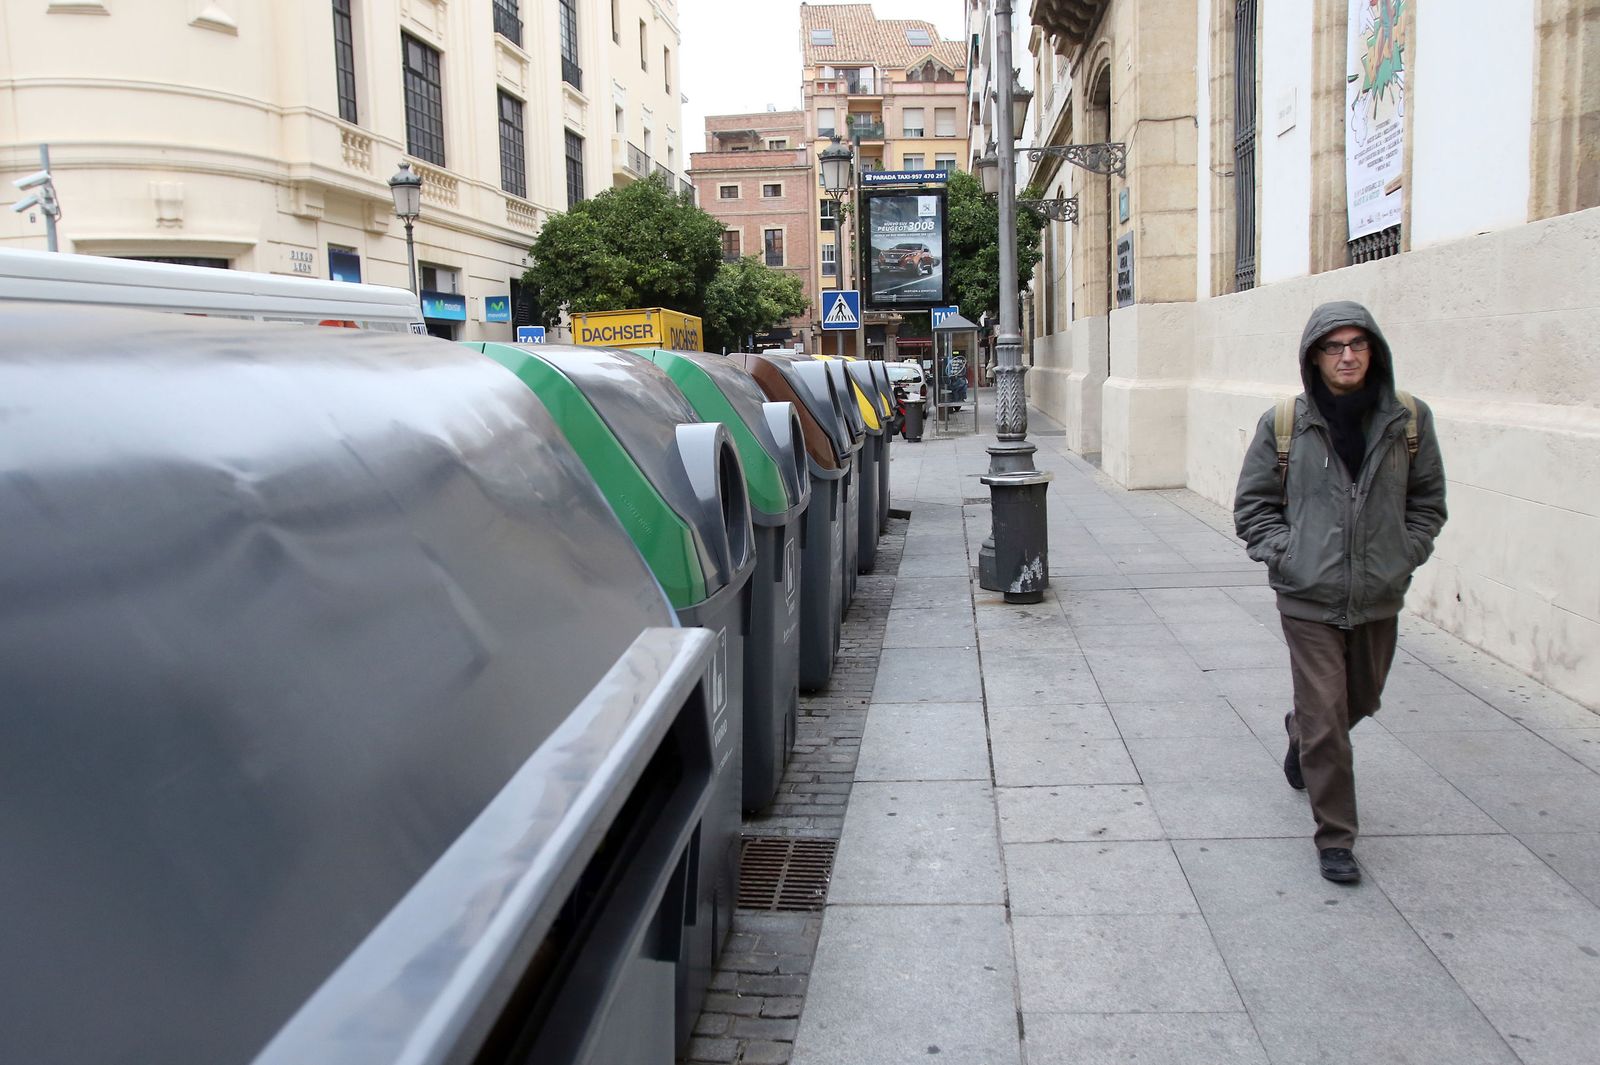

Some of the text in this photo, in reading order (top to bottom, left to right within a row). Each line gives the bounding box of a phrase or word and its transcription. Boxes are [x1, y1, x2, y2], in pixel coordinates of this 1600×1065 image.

[908, 221, 935, 231] 3008
[934, 312, 957, 326] TA
[582, 324, 653, 342] DACHSER
